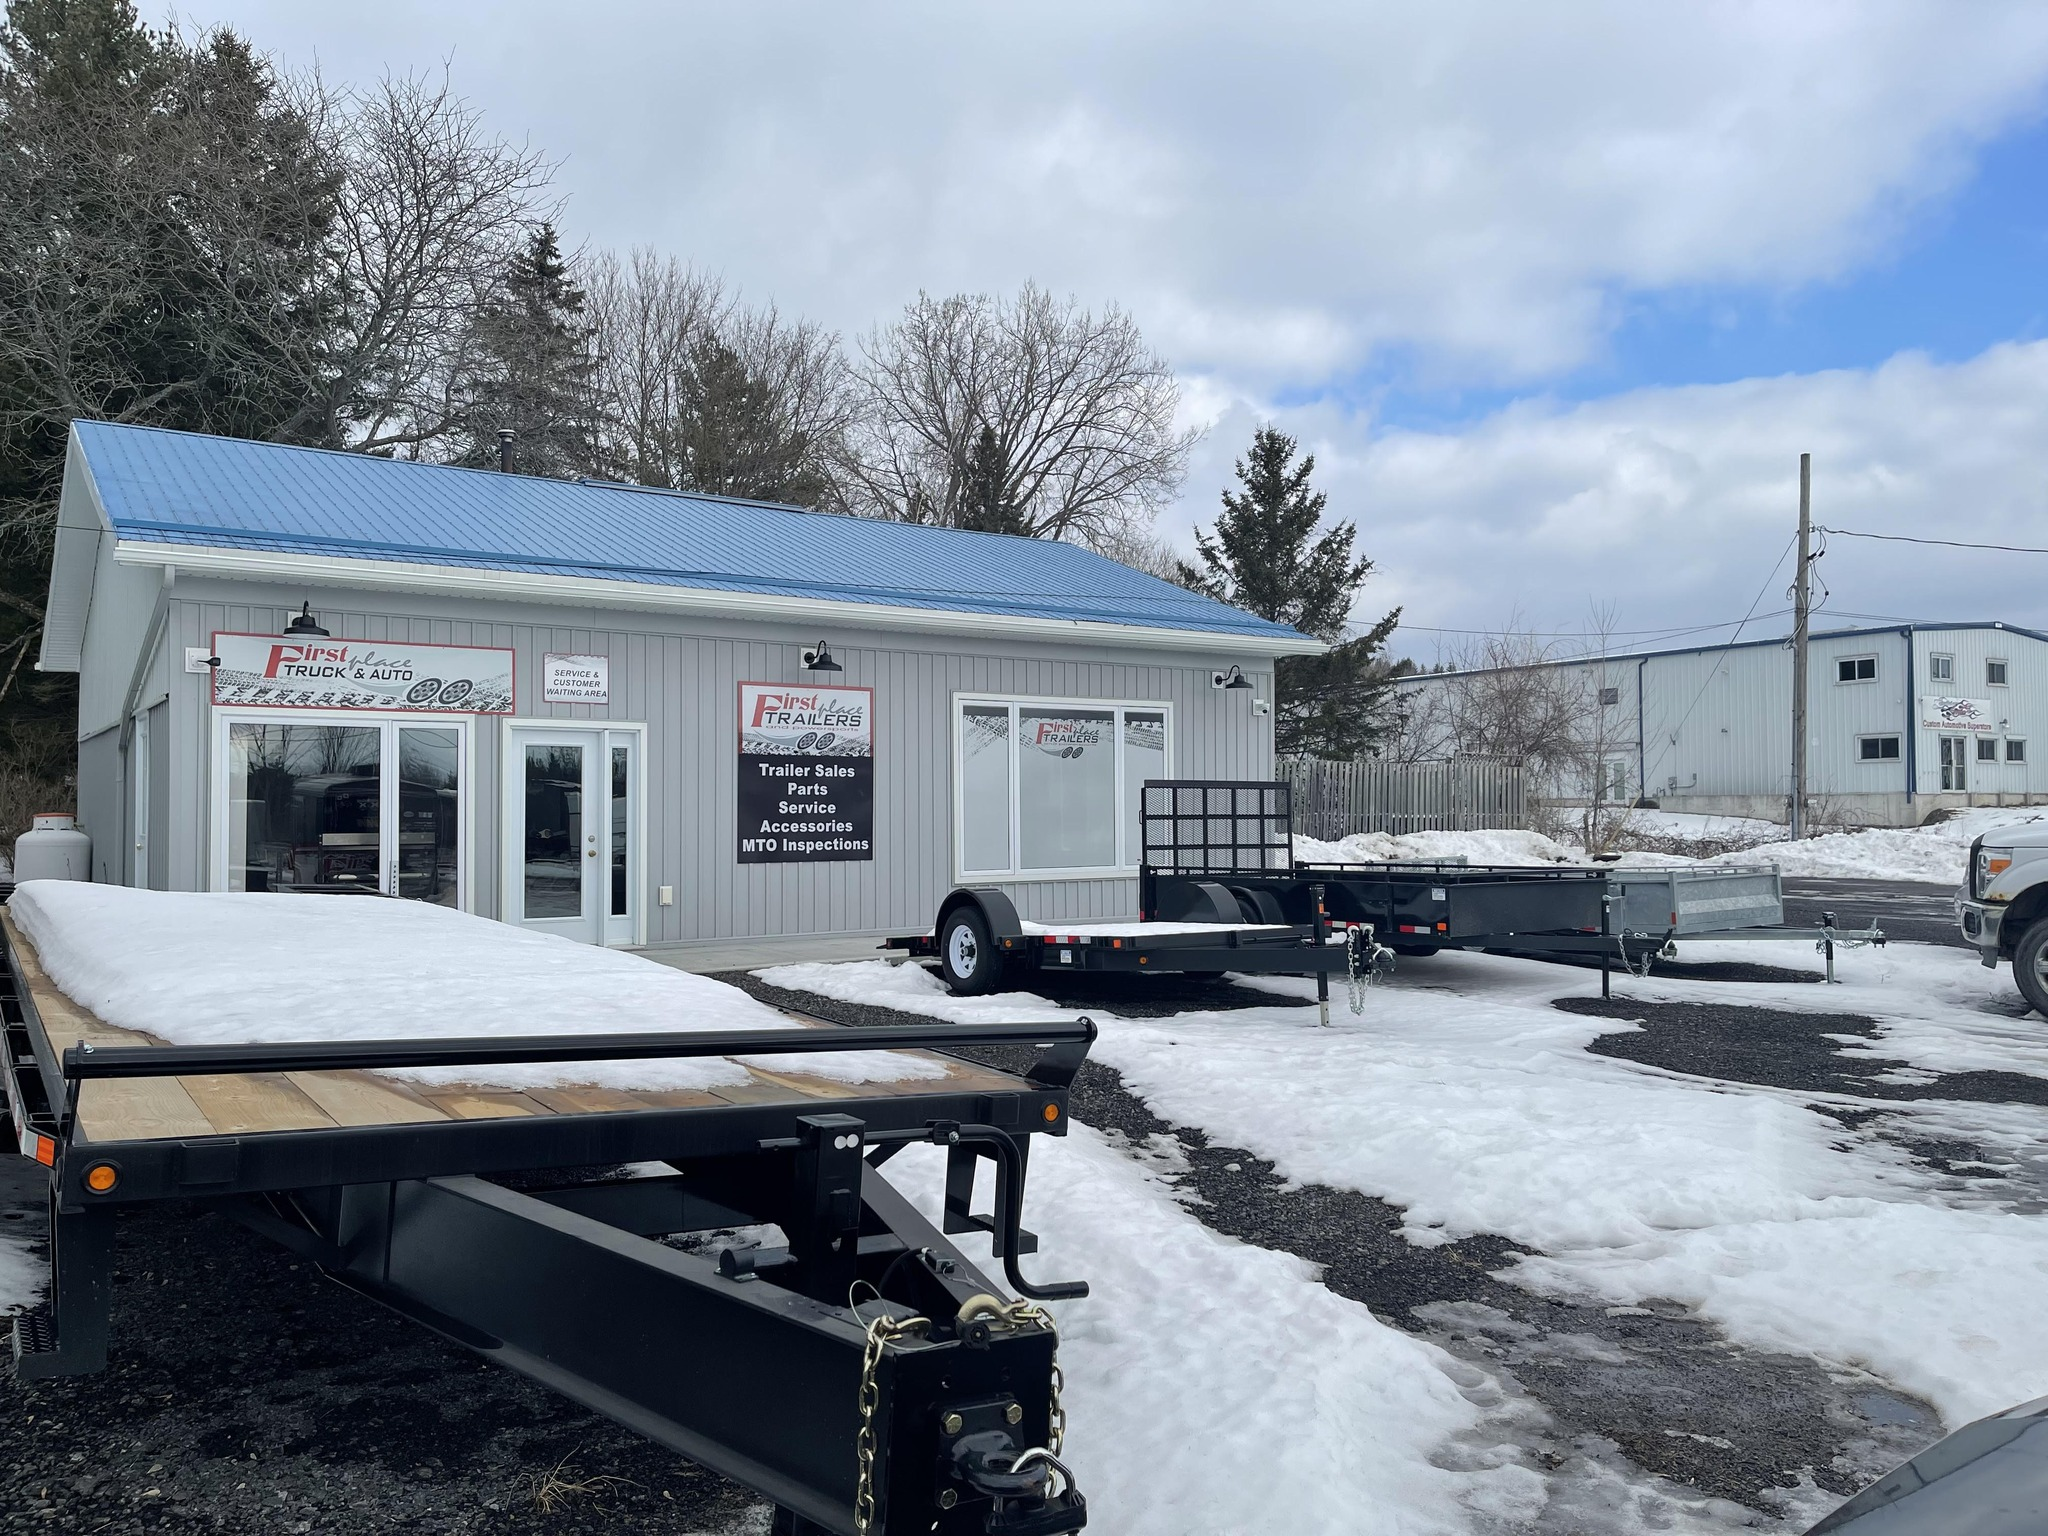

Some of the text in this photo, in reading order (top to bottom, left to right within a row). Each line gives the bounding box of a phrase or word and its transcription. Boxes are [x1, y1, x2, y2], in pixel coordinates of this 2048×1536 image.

[263, 643, 412, 678] First place
[284, 665, 413, 681] TRUCK & AUTO
[554, 669, 591, 678] SERVICE
[553, 679, 601, 687] CUSTOMER
[546, 688, 582, 696] WAITING
[751, 693, 863, 727] First place
[765, 712, 862, 727] TRAILERS
[1923, 720, 1941, 728] Custom
[1942, 721, 1967, 729] Automotive
[1036, 722, 1099, 744] First place
[1044, 733, 1099, 744] TRAILERS
[759, 763, 855, 778] Trailer Sales
[787, 782, 828, 796] Parts
[778, 800, 837, 814] Service
[760, 819, 853, 833] Accessories
[742, 837, 869, 854] MTO Inspections
